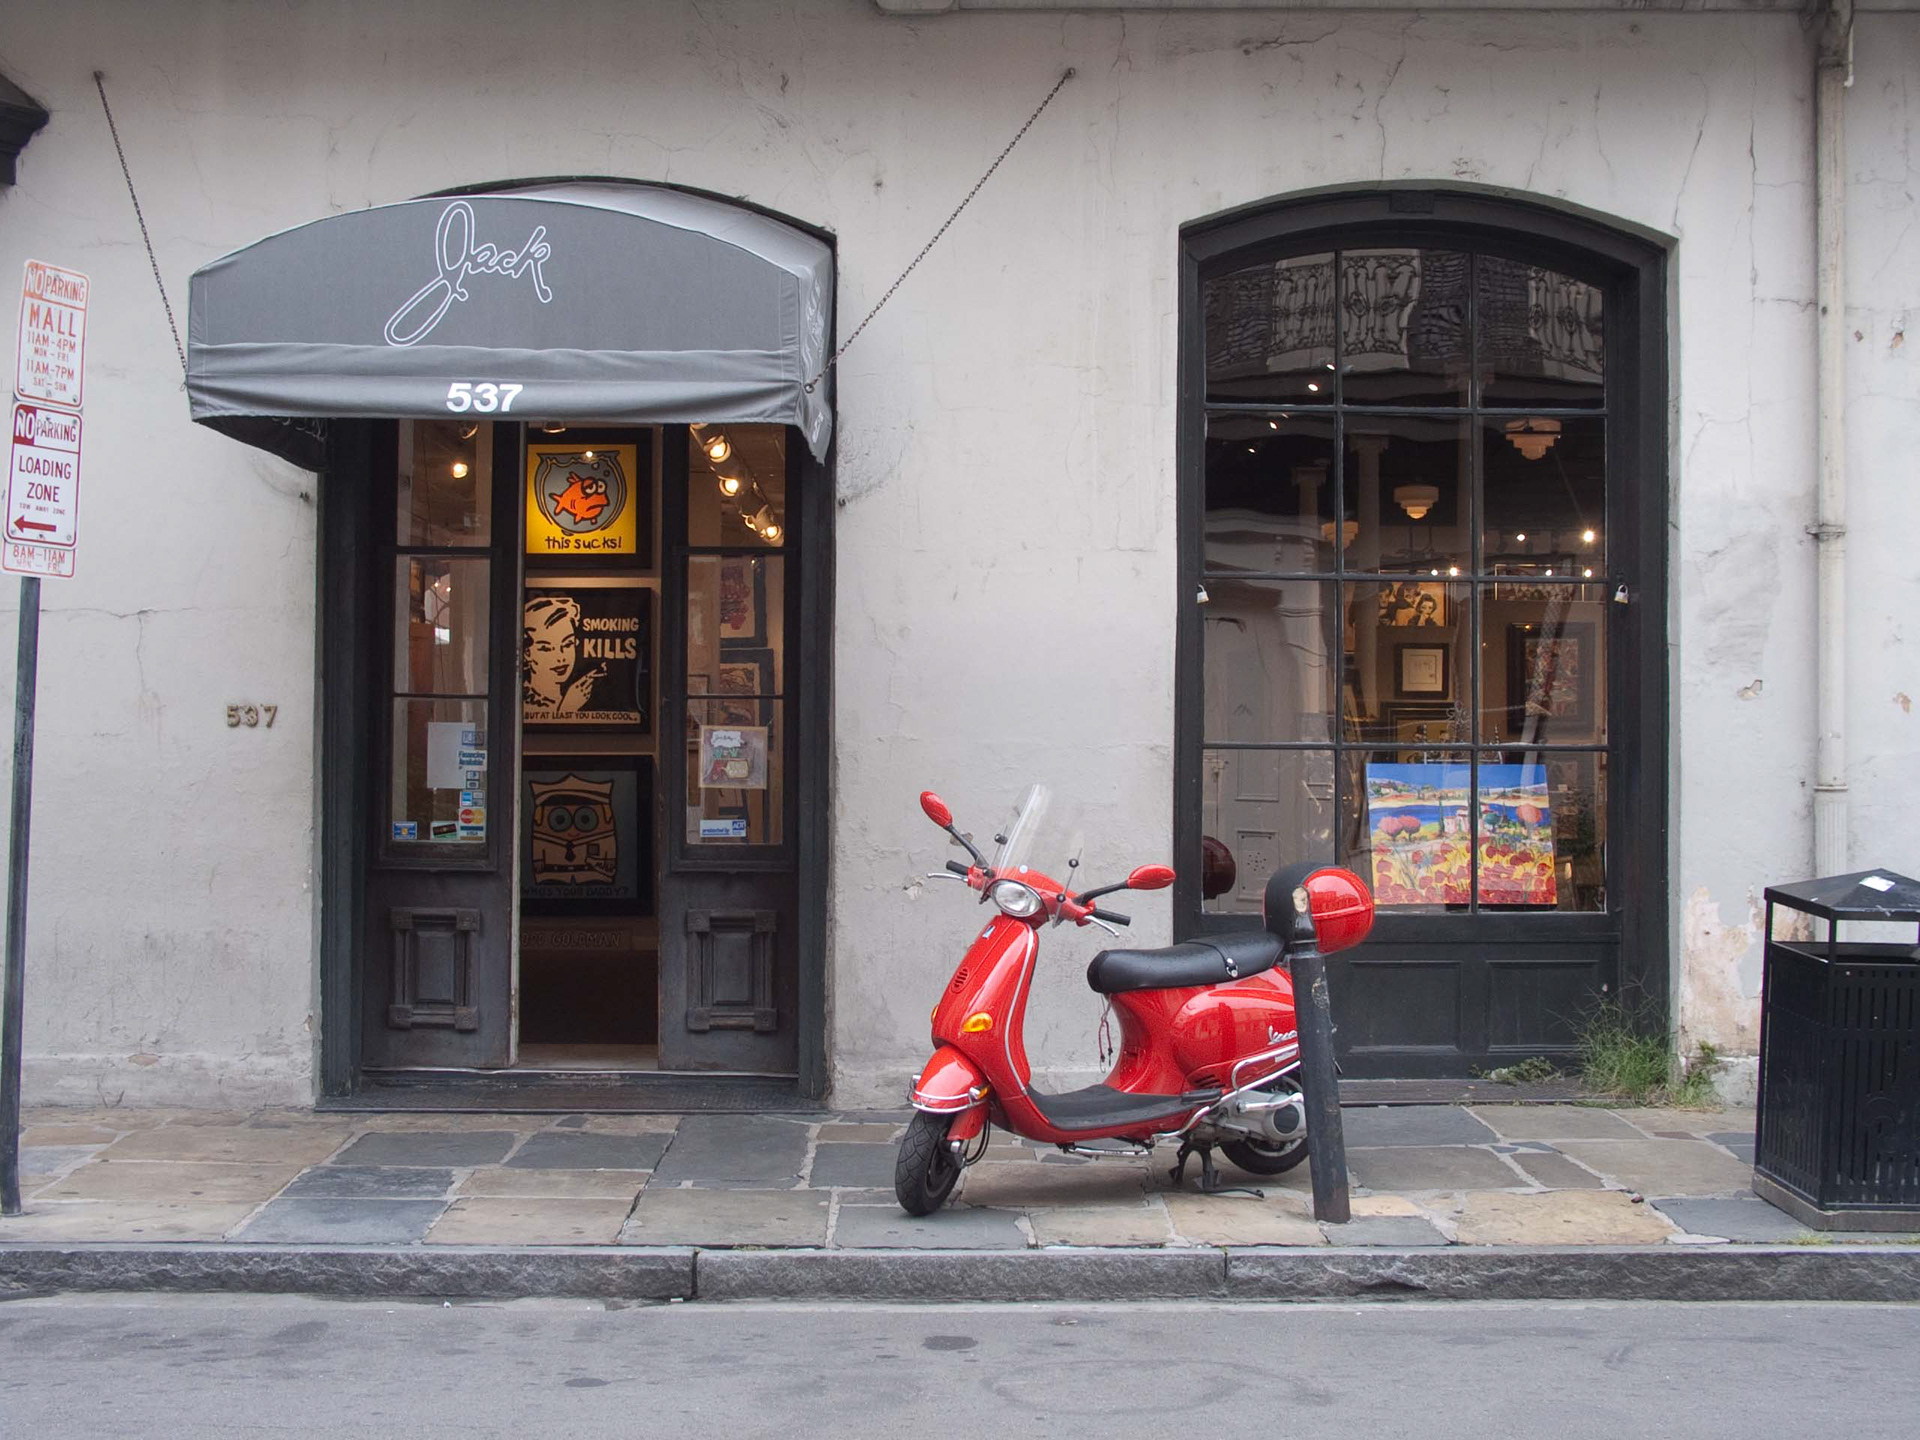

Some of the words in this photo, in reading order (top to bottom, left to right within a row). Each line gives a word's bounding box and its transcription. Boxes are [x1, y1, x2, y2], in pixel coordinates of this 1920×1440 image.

[26, 267, 45, 295] NO
[45, 275, 85, 302] PARKING
[384, 201, 553, 347] Jack
[29, 303, 76, 337] MALL
[446, 382, 524, 413] 537
[15, 409, 35, 439] NO
[36, 419, 77, 443] PARKING
[18, 455, 72, 480] LOADING
[26, 482, 60, 503] ZONE
[13, 544, 66, 564] 8AM-11AM
[545, 535, 571, 550] this
[574, 535, 622, 550] sucks!
[582, 617, 639, 633] SMOKING
[583, 637, 637, 660] KILLS
[227, 704, 278, 728] 537
[525, 711, 540, 721] BUT
[551, 710, 573, 720] LEAST
[574, 710, 589, 720] YOU
[591, 711, 610, 721] LOOK
